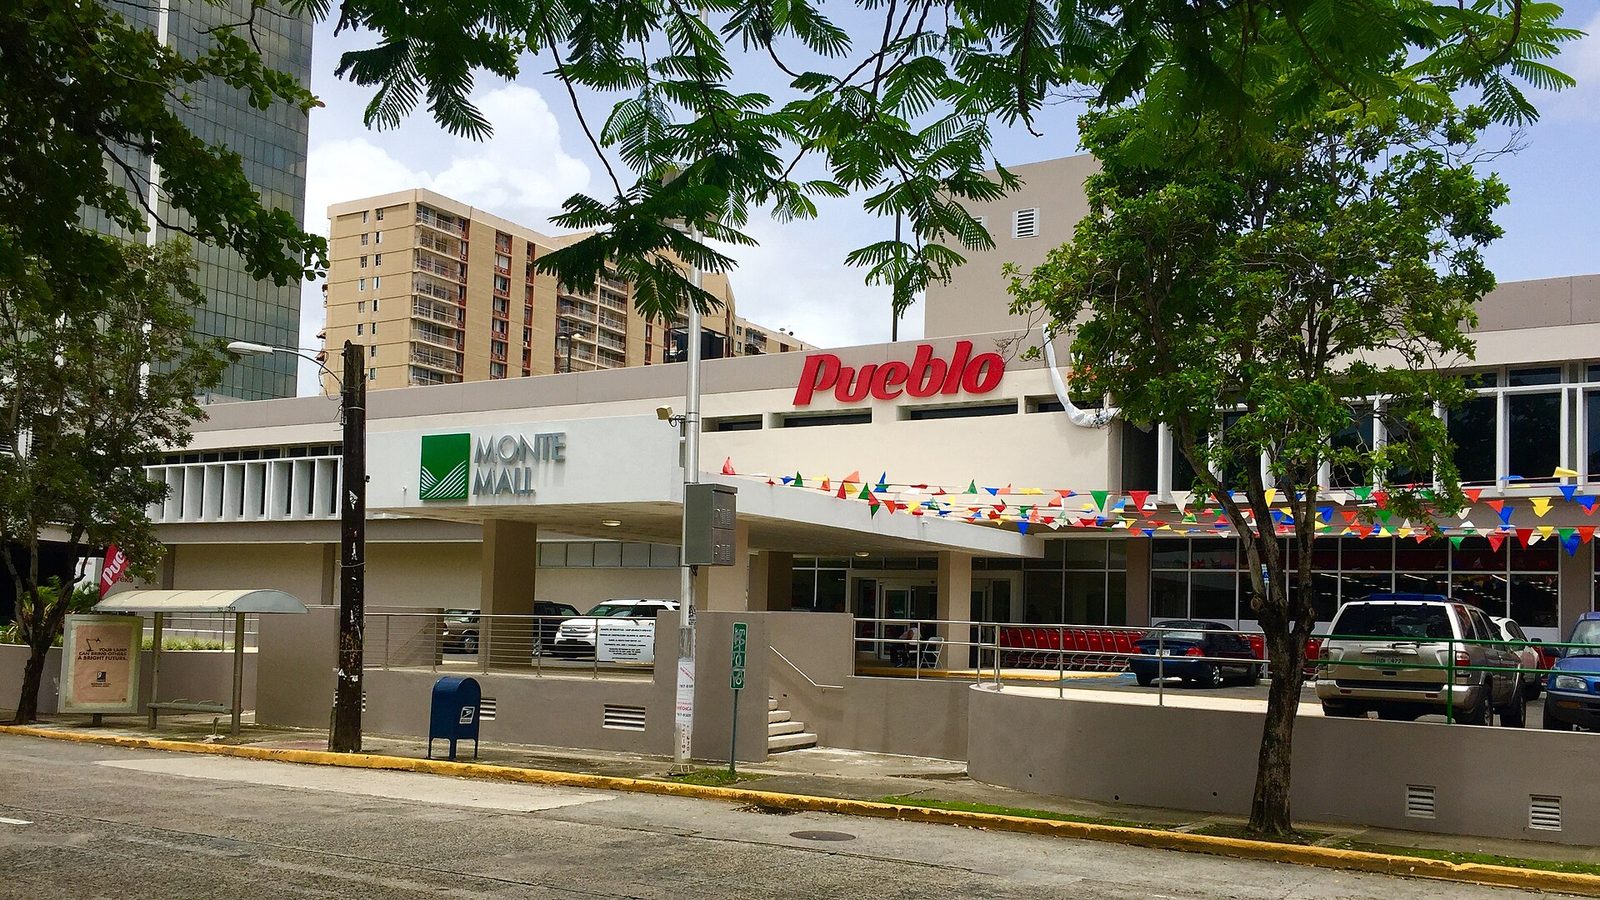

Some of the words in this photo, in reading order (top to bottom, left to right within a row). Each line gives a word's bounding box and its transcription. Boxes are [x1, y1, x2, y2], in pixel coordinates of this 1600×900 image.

[792, 340, 1006, 406] Pueblo
[474, 433, 566, 464] MONTE
[473, 467, 536, 496] MALL
[102, 551, 125, 586] Pue
